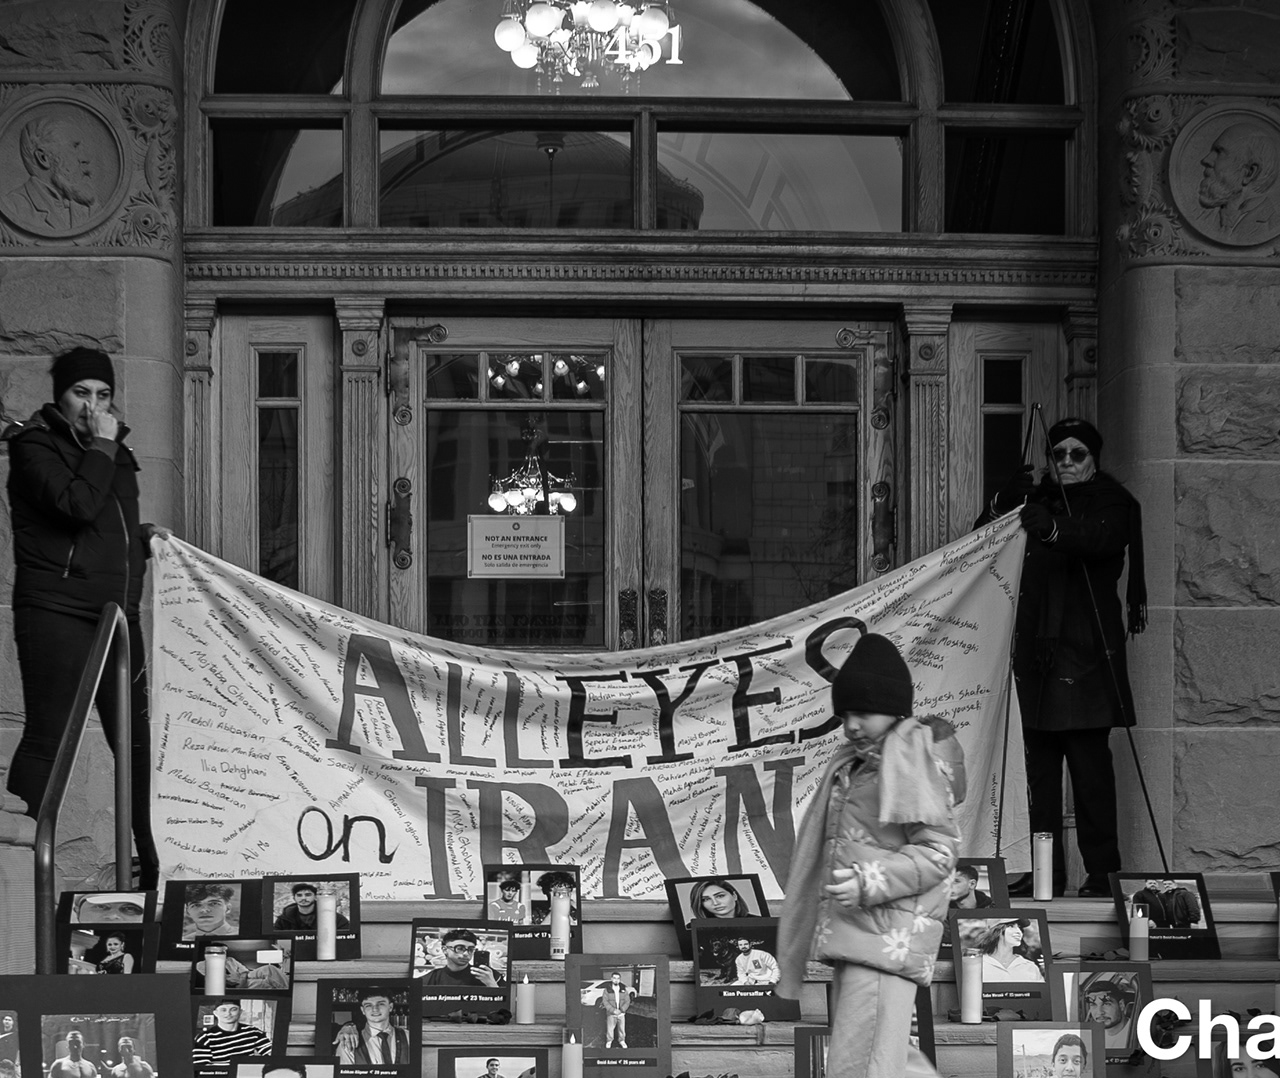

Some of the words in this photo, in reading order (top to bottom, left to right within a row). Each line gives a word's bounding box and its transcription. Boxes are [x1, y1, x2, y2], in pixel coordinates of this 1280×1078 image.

[605, 24, 683, 65] 451
[298, 805, 399, 864] on
[414, 764, 805, 901] IRAN
